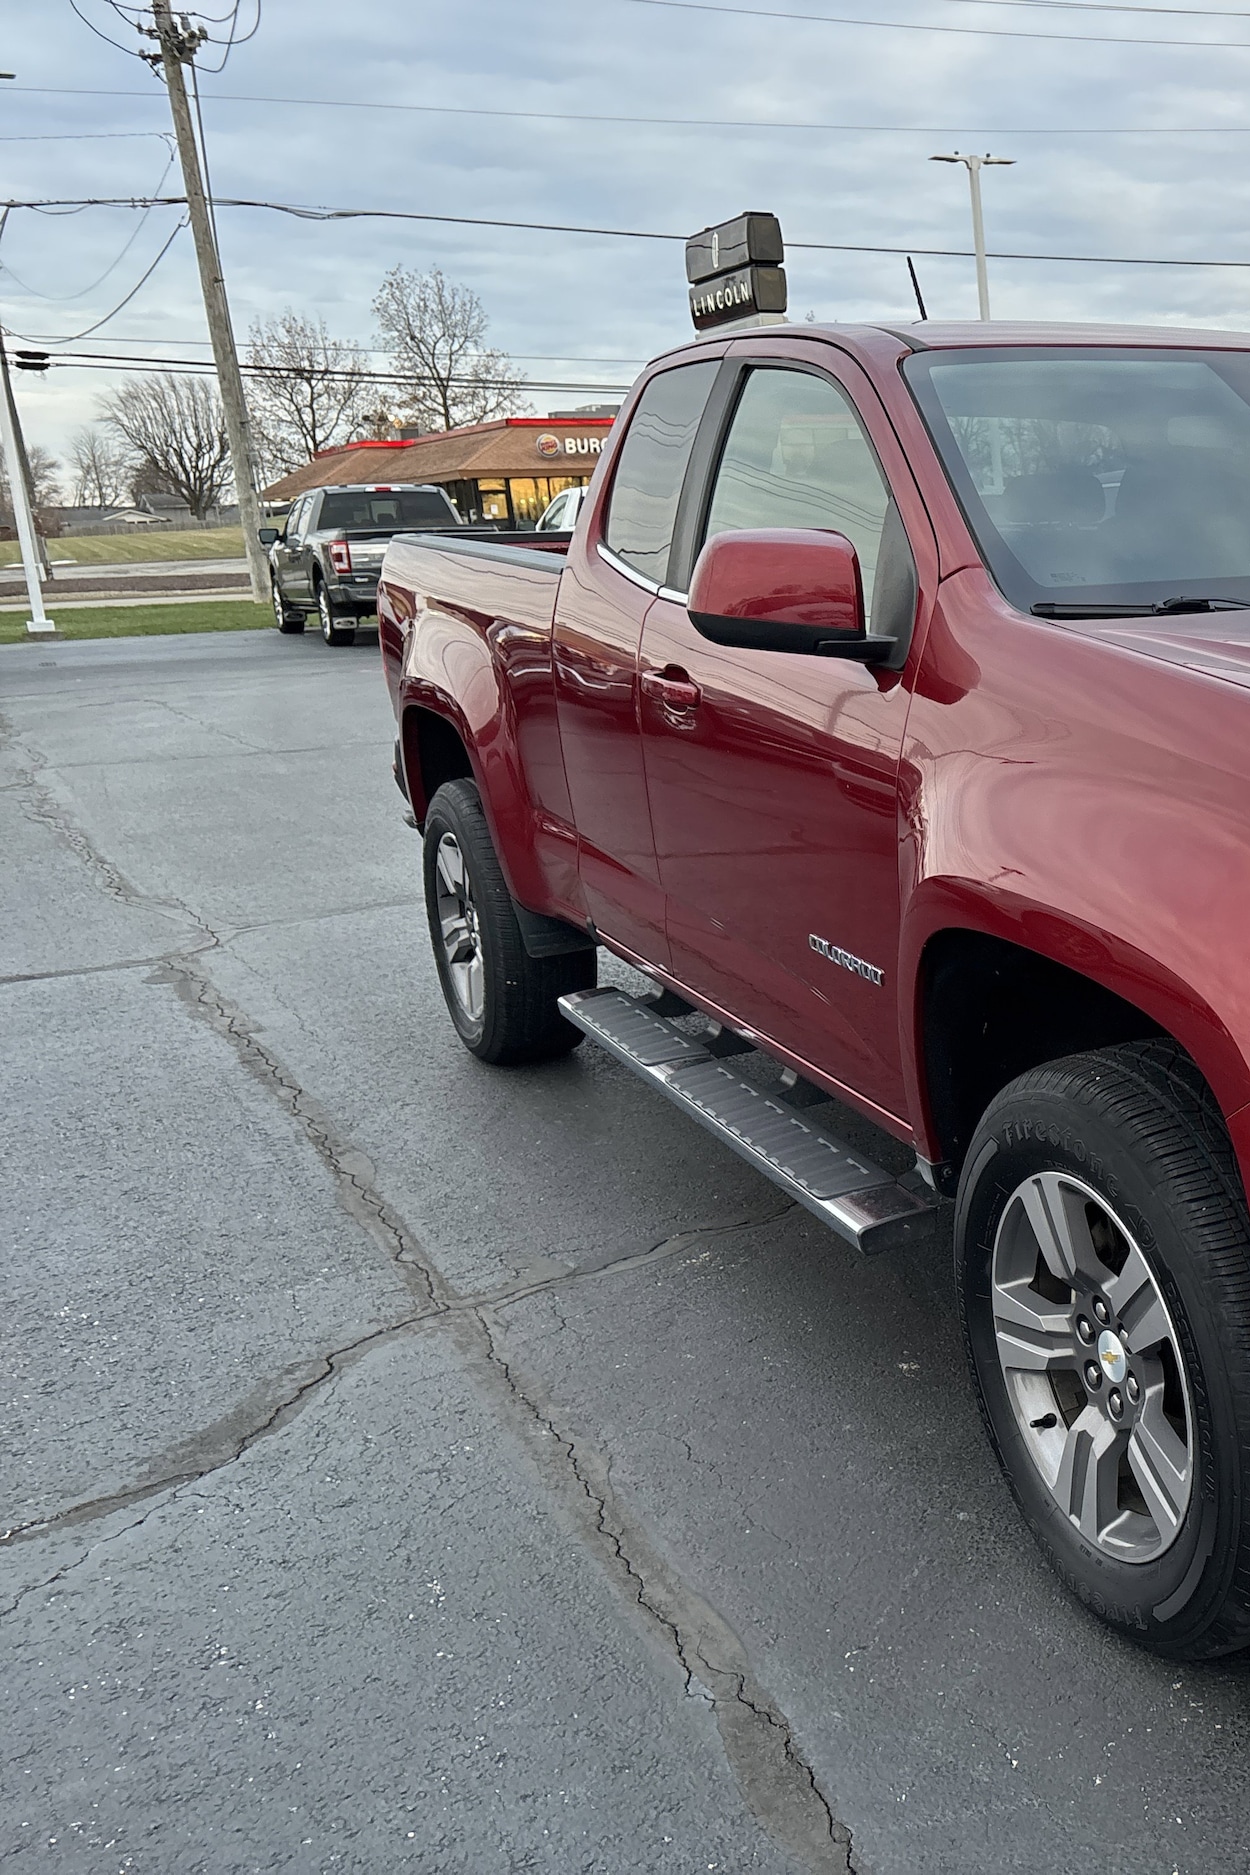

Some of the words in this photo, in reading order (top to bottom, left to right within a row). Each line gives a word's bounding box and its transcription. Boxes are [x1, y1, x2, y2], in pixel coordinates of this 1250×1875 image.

[693, 281, 750, 317] LINCOLN
[808, 933, 884, 987] COLORADO
[1001, 1118, 1120, 1198] Firestone
